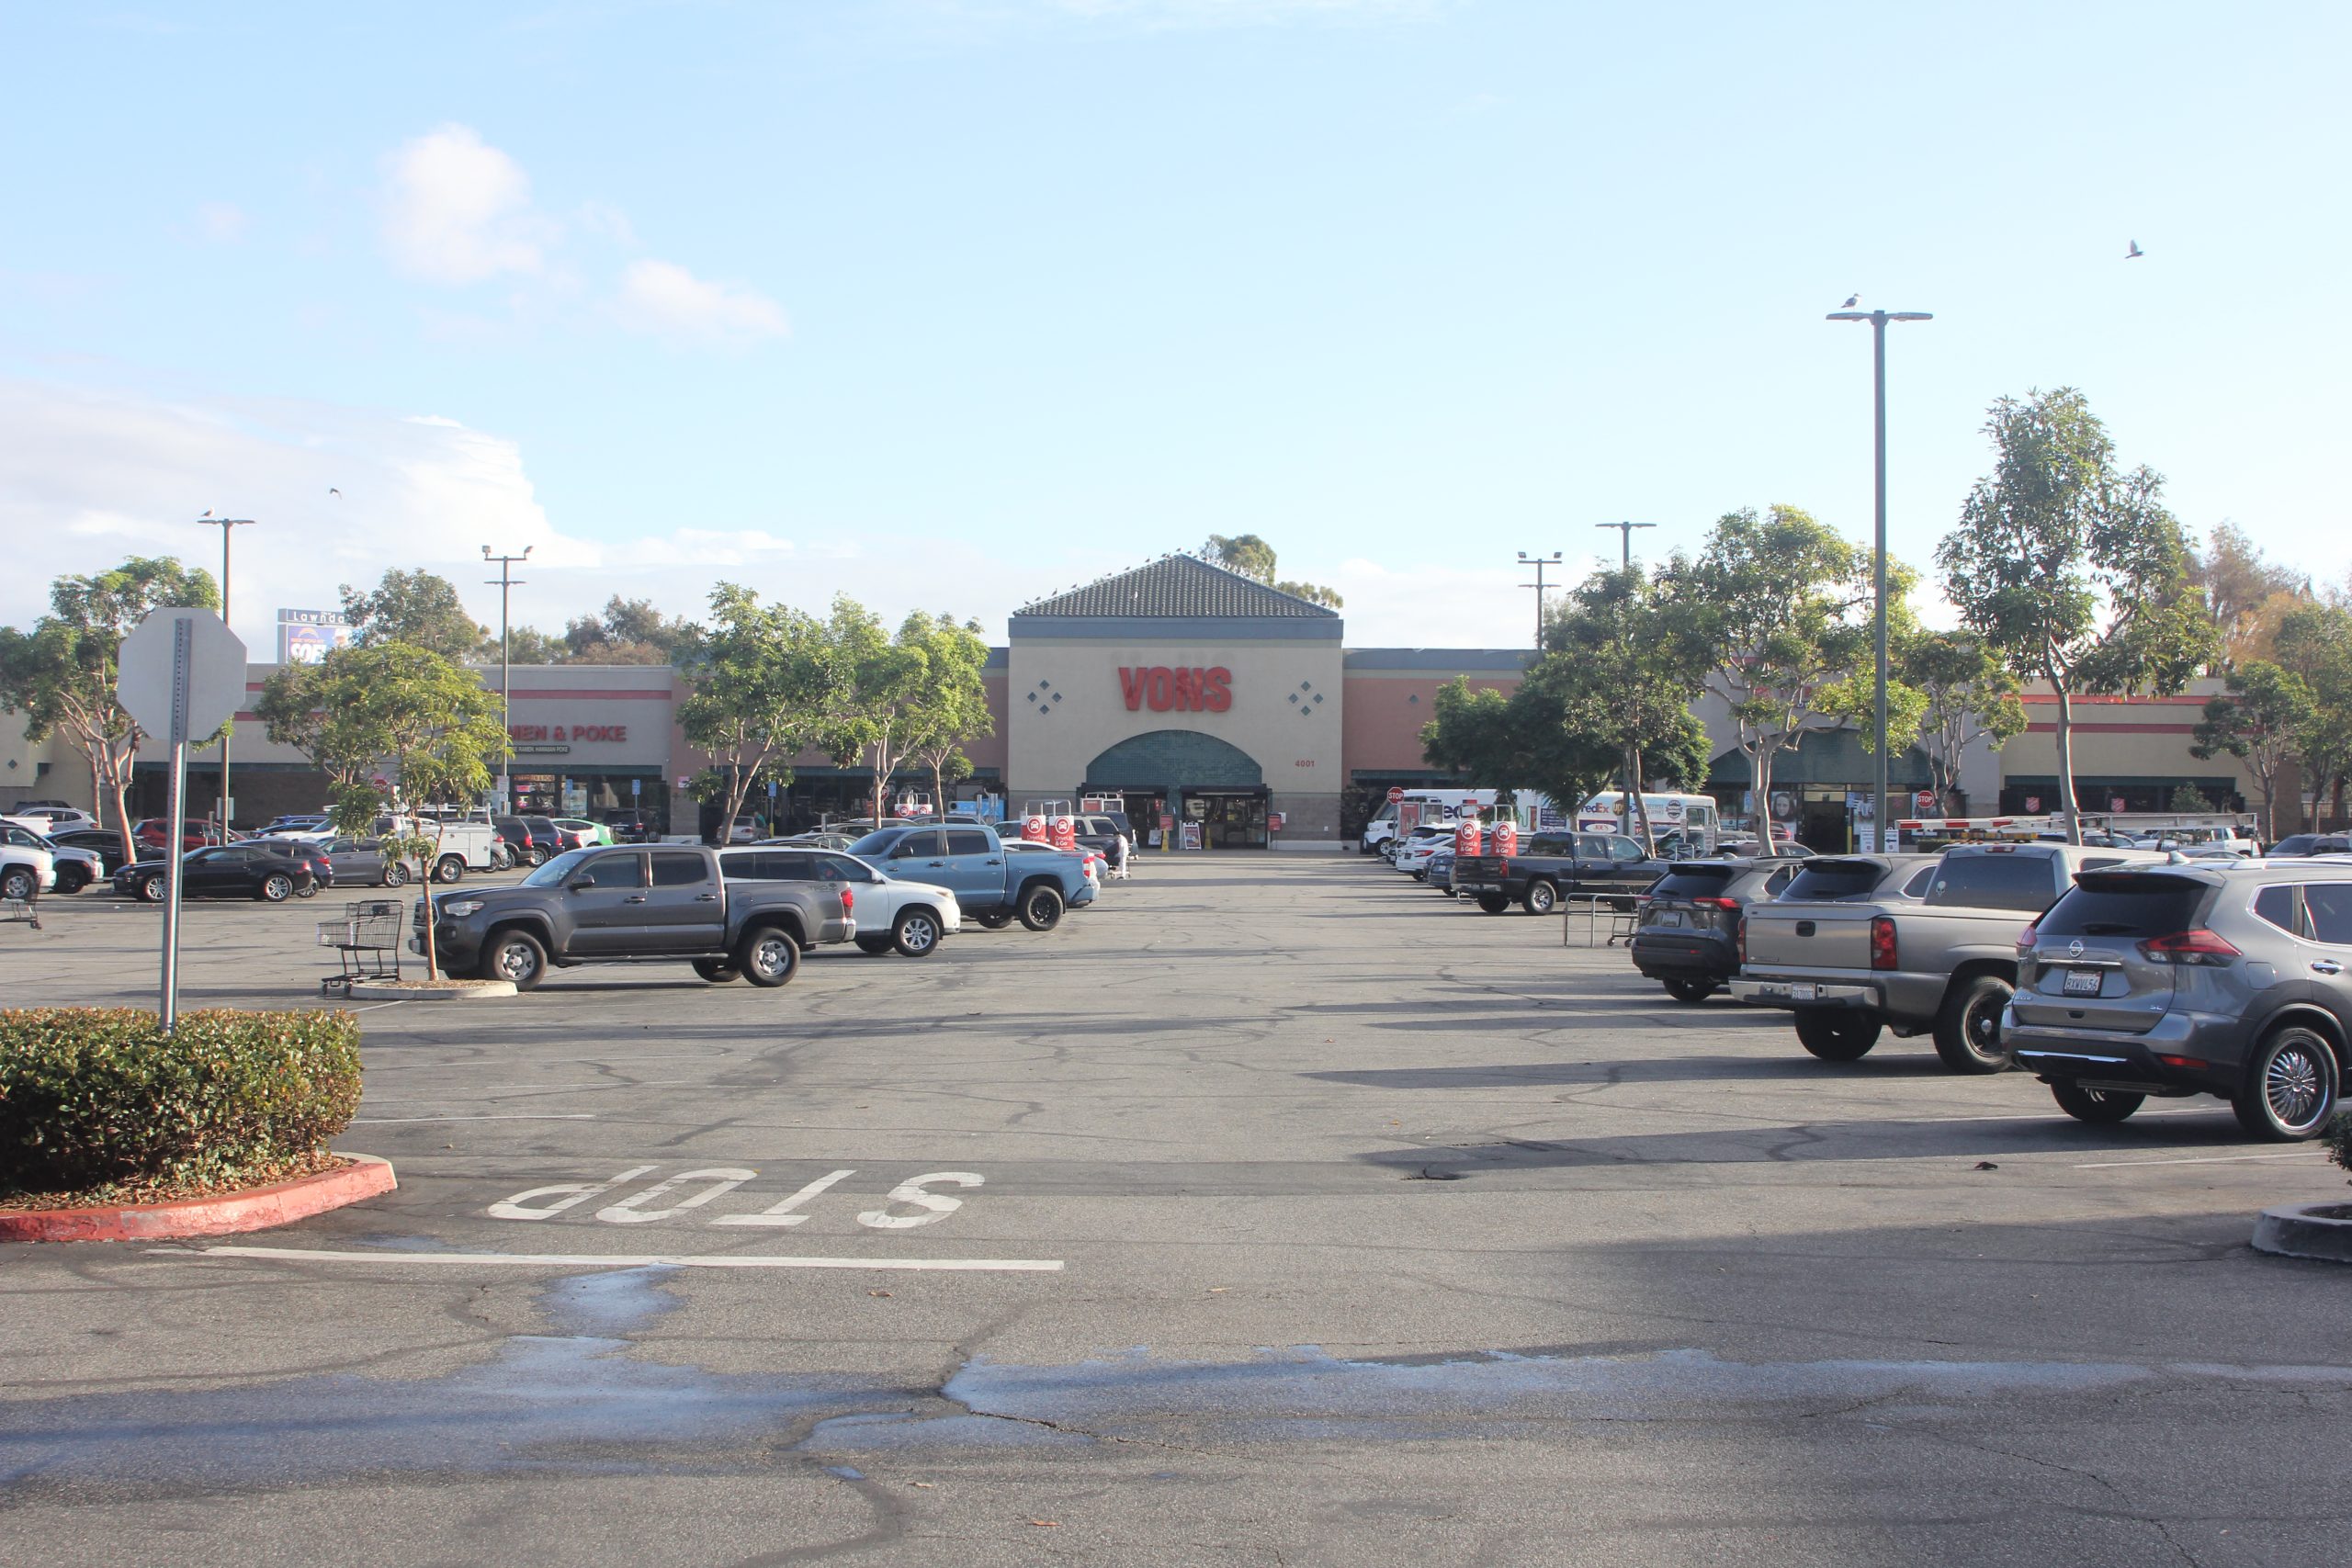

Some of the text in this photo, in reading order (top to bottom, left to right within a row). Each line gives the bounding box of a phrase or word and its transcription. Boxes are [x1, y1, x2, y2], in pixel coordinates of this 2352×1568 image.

[294, 611, 345, 623] Lawnda
[1118, 666, 1232, 713] VONS
[507, 725, 628, 743] MEN & POKE
[1295, 760, 1316, 768] 4001
[1388, 792, 1404, 800] STOP
[487, 1165, 986, 1229] STOP
